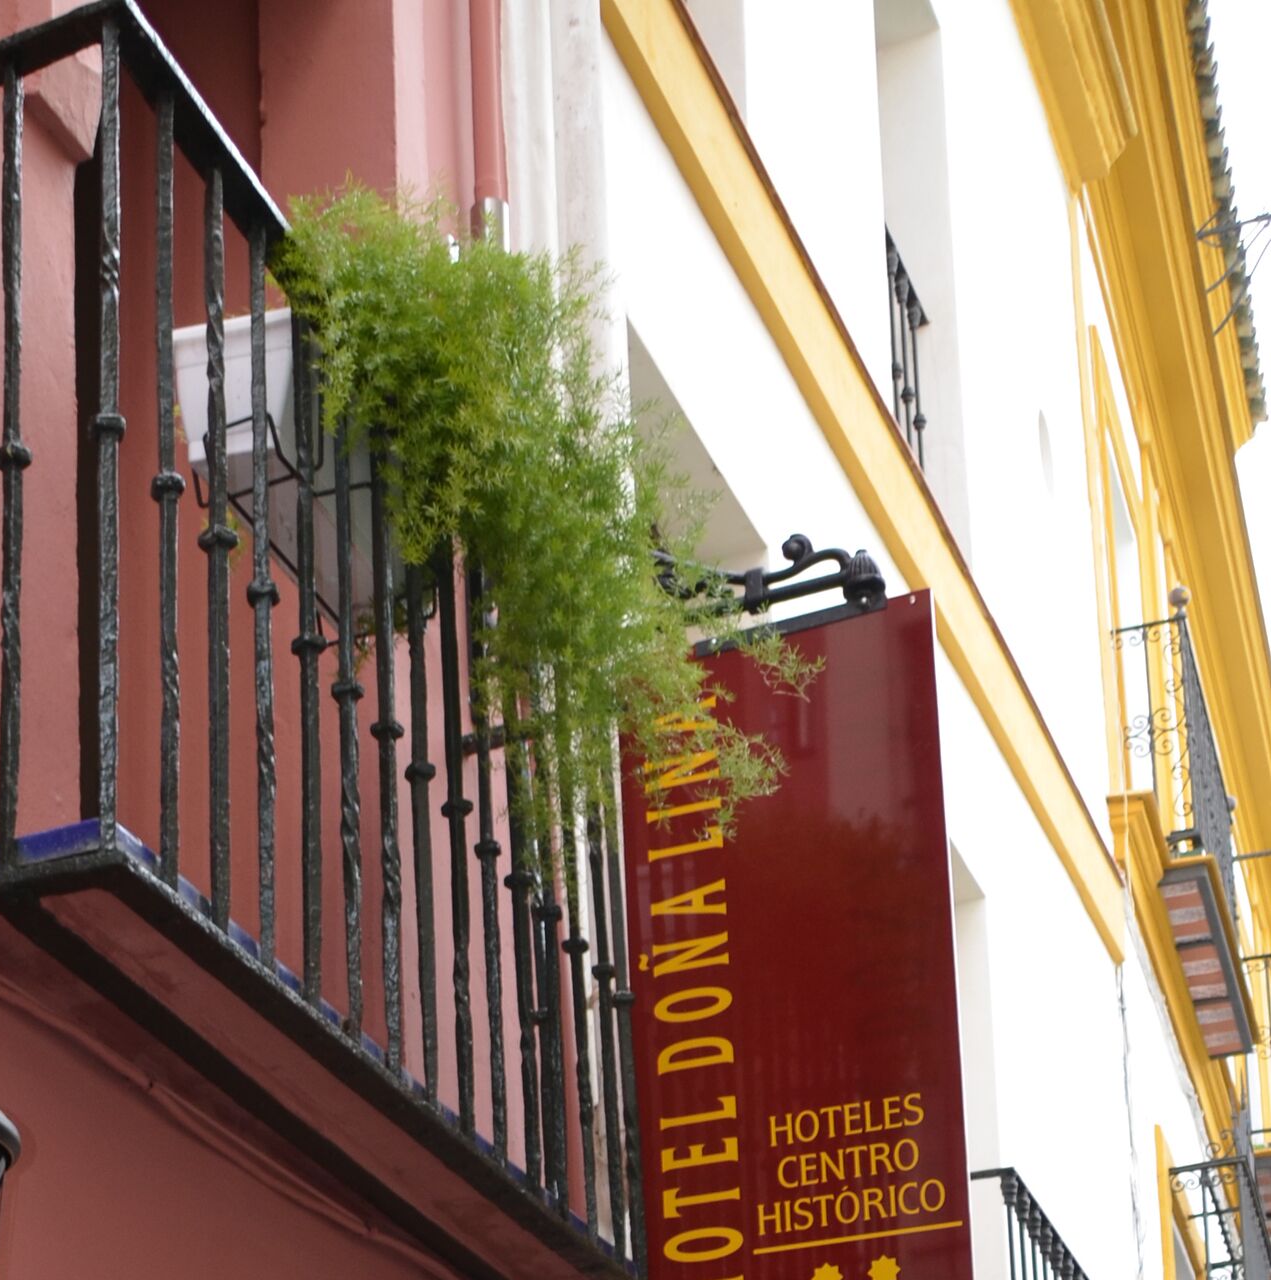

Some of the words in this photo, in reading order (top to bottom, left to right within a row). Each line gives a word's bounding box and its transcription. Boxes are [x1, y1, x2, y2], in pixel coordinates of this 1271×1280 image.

[638, 878, 735, 1076] DOÑA
[769, 1092, 925, 1148] HOTELES
[777, 1138, 920, 1189] CENTRO
[756, 1178, 946, 1237] HISTÓRICO
